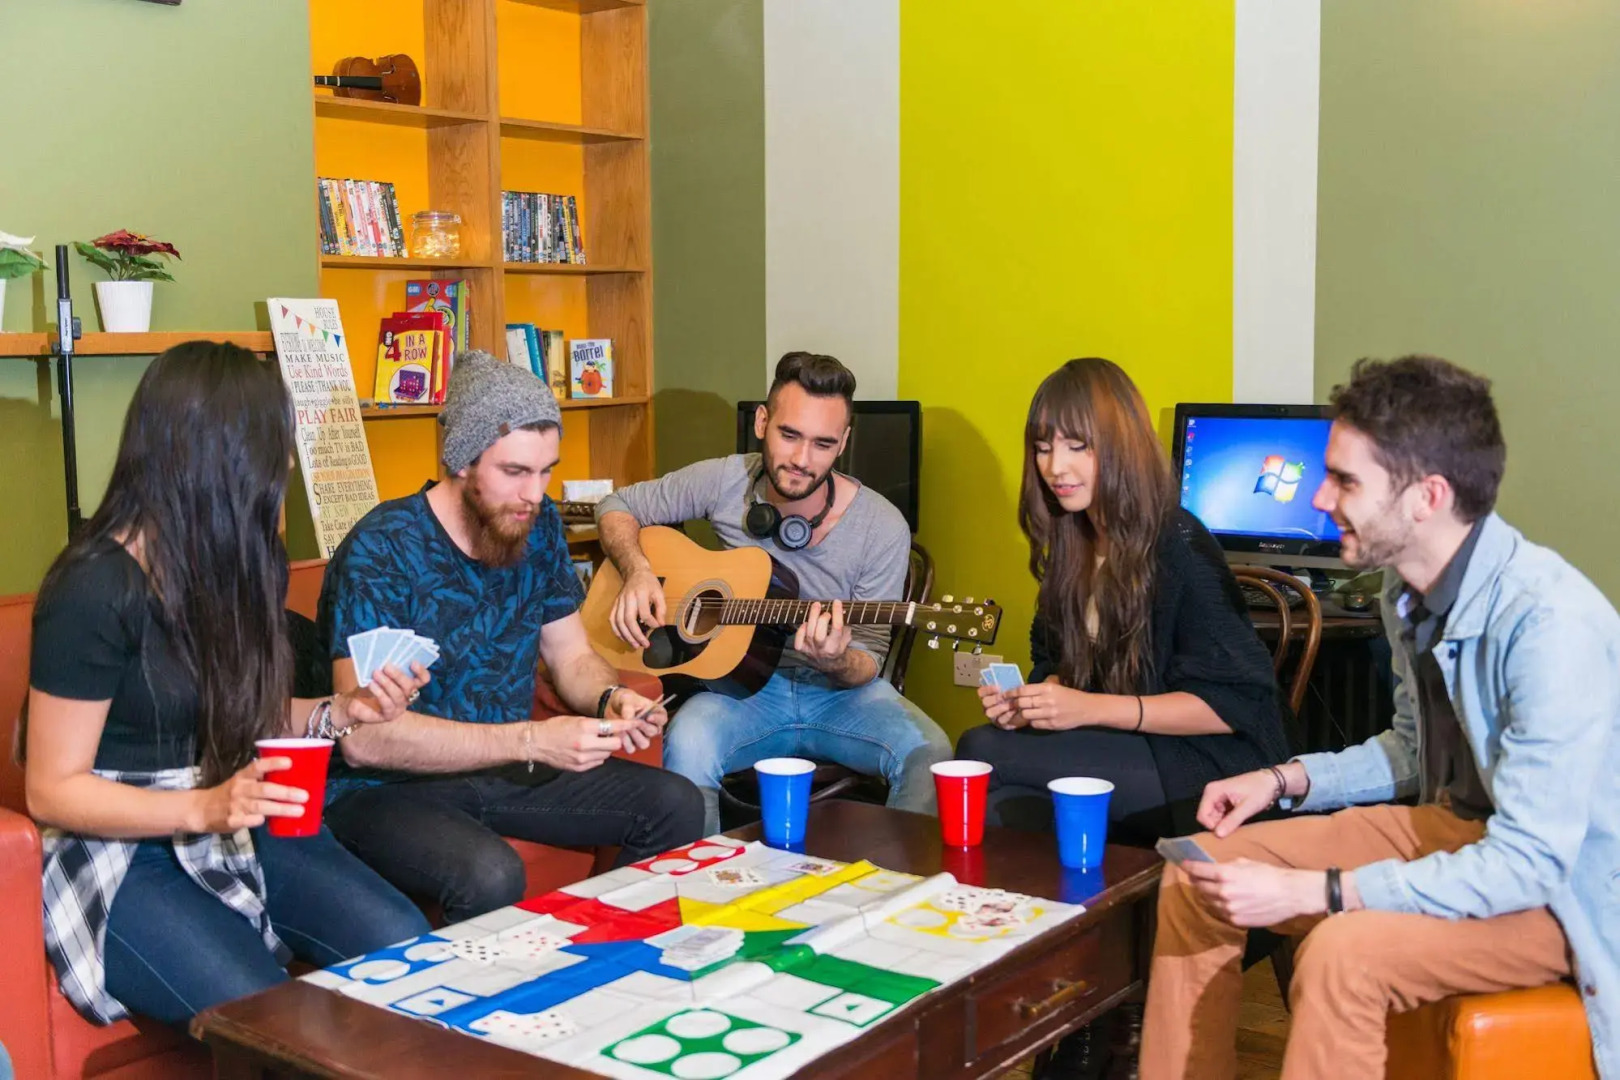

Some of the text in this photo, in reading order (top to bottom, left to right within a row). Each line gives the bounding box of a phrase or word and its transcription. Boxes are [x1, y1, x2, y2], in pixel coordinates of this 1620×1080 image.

[314, 307, 336, 319] HOUSE
[406, 333, 425, 347] IN A
[385, 340, 402, 362] 4
[404, 347, 427, 361] ROW
[285, 354, 345, 363] MAKE MUSIC
[288, 363, 348, 379] Use Kind Words
[294, 380, 315, 393] PLEASE
[318, 380, 338, 392] THANK
[298, 407, 358, 424] PLAY FAIR
[334, 442, 344, 453] TV
[350, 441, 365, 452] BAD
[313, 479, 373, 505] SHARE EVERYTHING
[323, 491, 375, 504] EXCEPT BAD IDEAS
[320, 520, 334, 532] Take
[334, 519, 347, 530] Care
[323, 533, 335, 545] SAY
